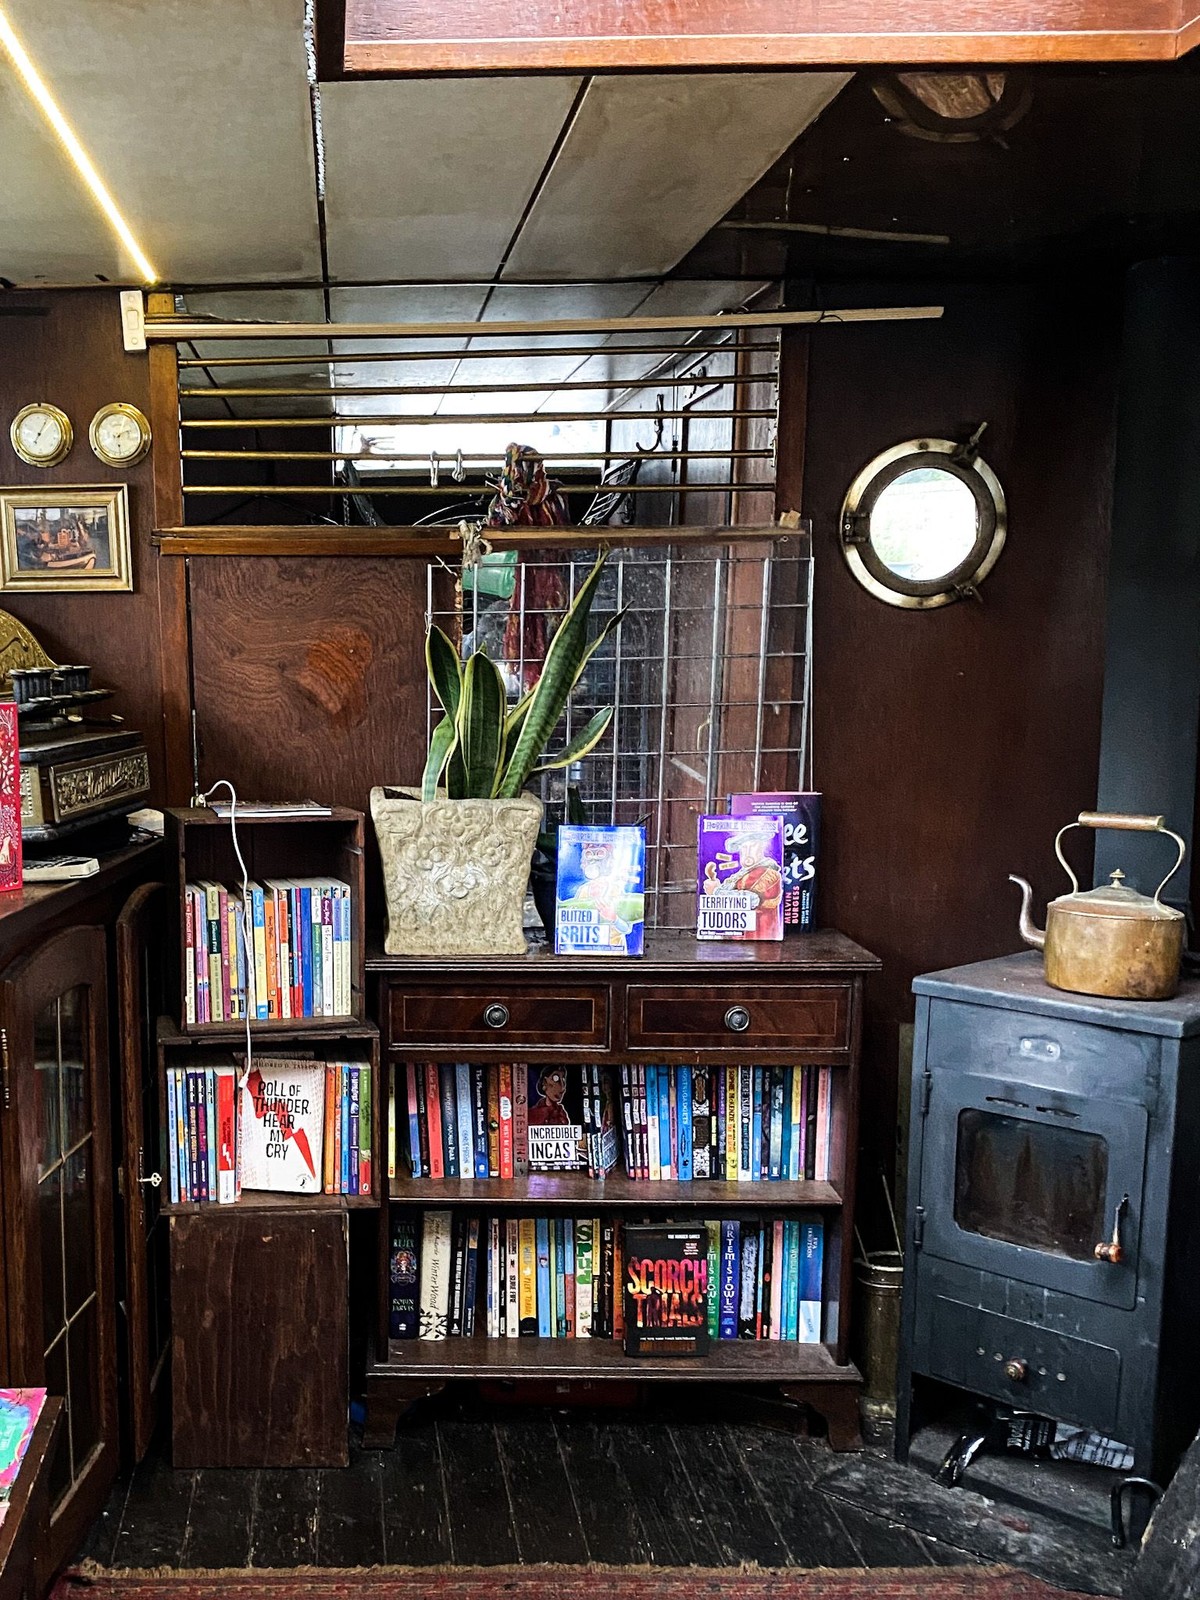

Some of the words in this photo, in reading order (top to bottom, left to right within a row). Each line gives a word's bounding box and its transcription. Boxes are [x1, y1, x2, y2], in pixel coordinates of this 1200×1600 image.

[702, 897, 747, 909] TERRIFYING
[792, 886, 800, 924] BURGESS
[561, 910, 592, 922] BLITZED
[702, 912, 747, 929] TUDORS
[560, 925, 600, 944] BRITS
[258, 1080, 286, 1097] ROLL
[289, 1085, 302, 1097] OF
[253, 1096, 312, 1115] THUNDER,
[502, 1099, 510, 1118] HELLO
[263, 1114, 295, 1129] HEAR
[477, 1108, 485, 1136] Tollbooth
[269, 1129, 287, 1143] MY
[530, 1126, 578, 1139] INCREDIBLE
[265, 1144, 289, 1160] CRY
[531, 1142, 570, 1159] INCAS
[627, 1256, 707, 1294] SCORCH
[706, 1276, 717, 1306] FOWL
[723, 1276, 736, 1306] FOWL
